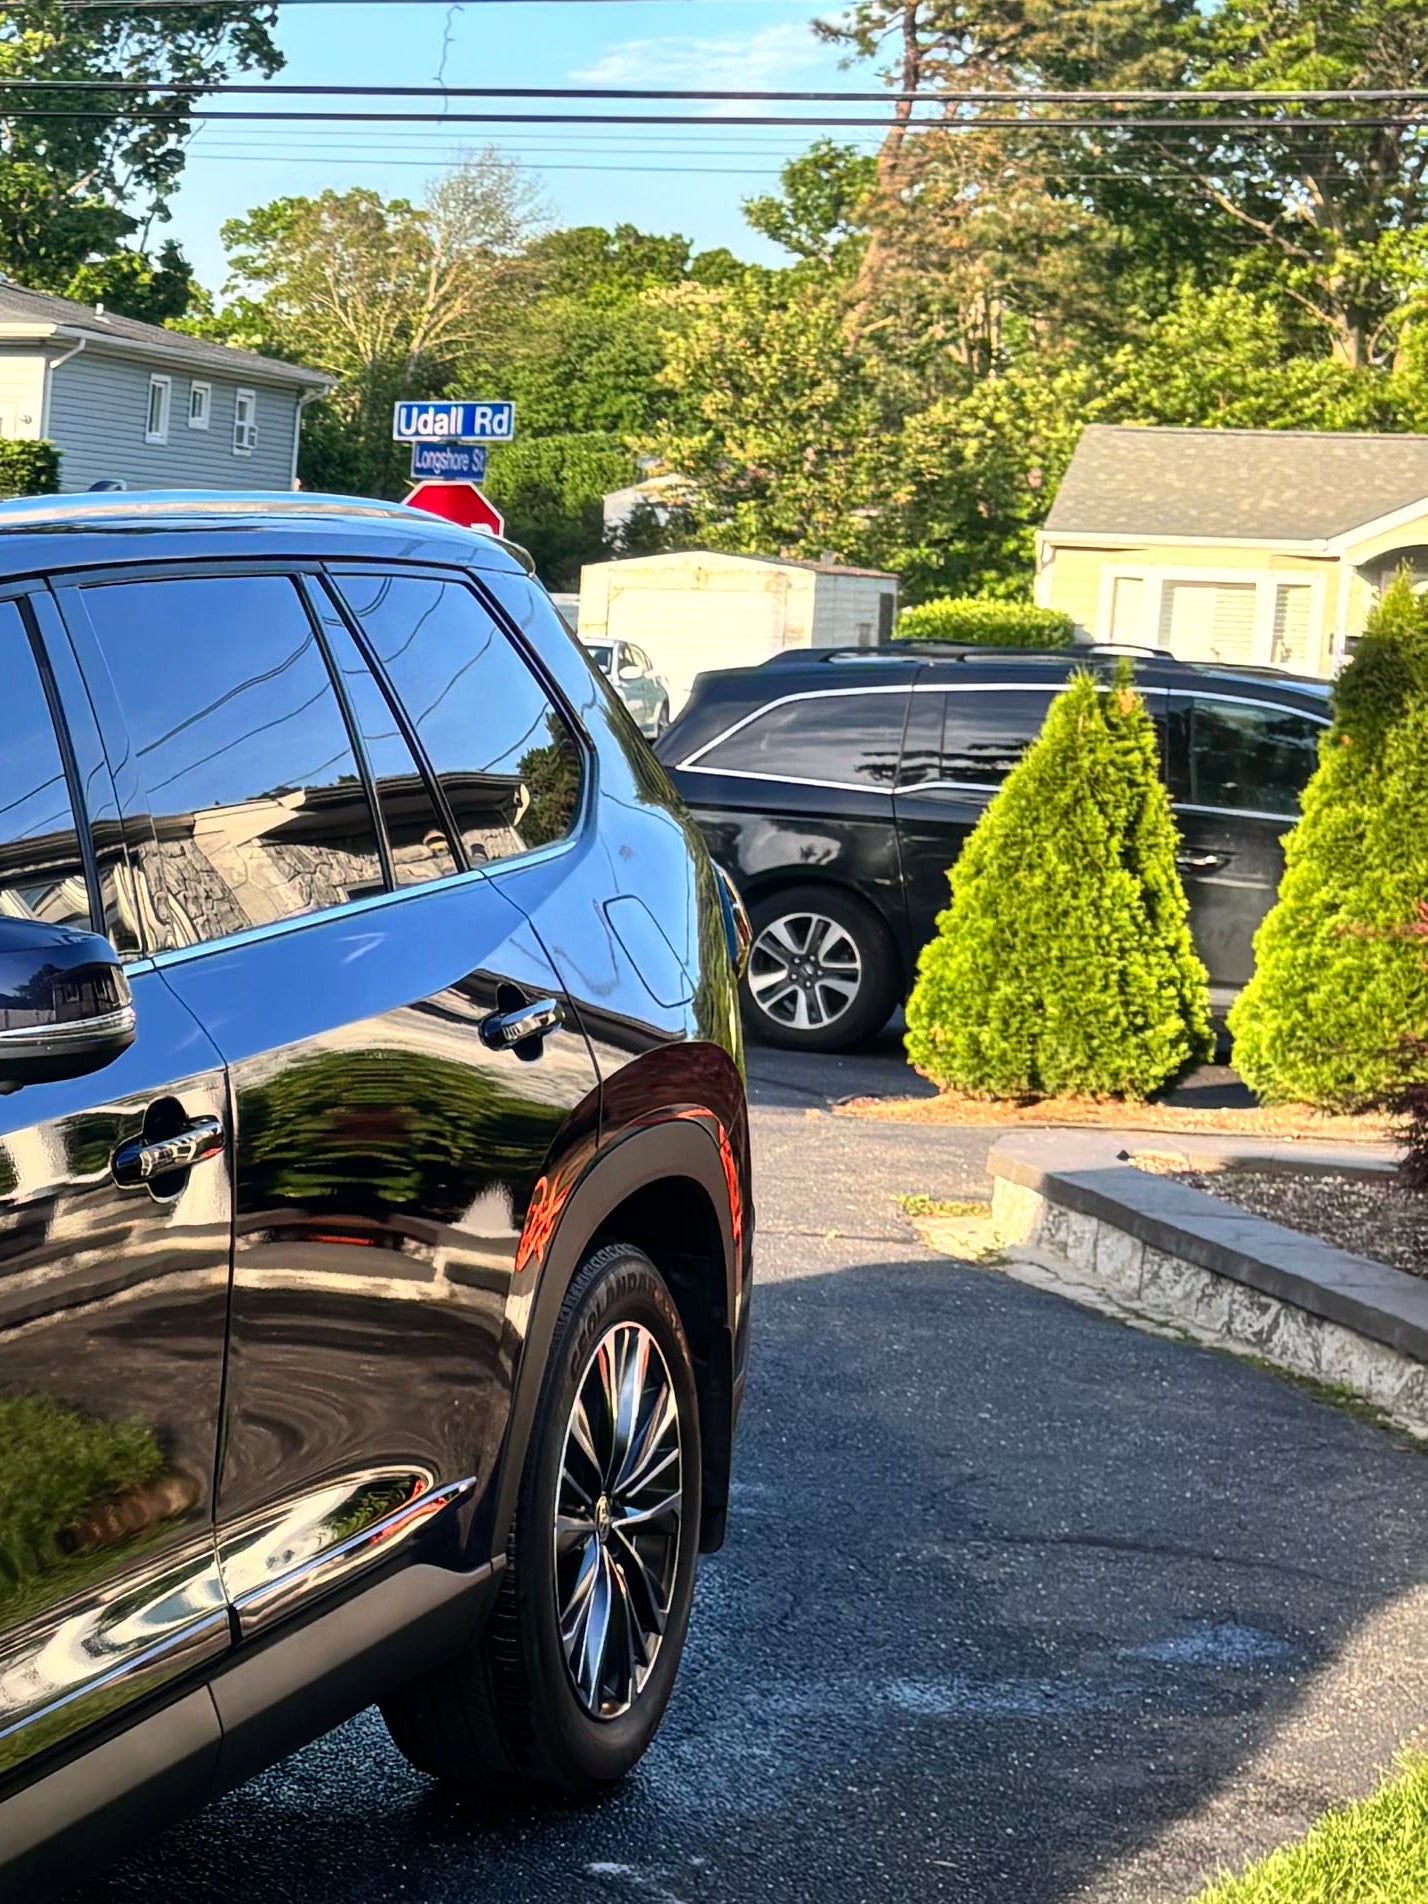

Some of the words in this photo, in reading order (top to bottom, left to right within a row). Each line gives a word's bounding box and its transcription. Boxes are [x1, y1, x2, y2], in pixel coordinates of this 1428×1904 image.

[399, 406, 464, 435] Udall
[474, 406, 510, 435] Rd
[414, 445, 469, 474] Longshore
[472, 449, 485, 473] St
